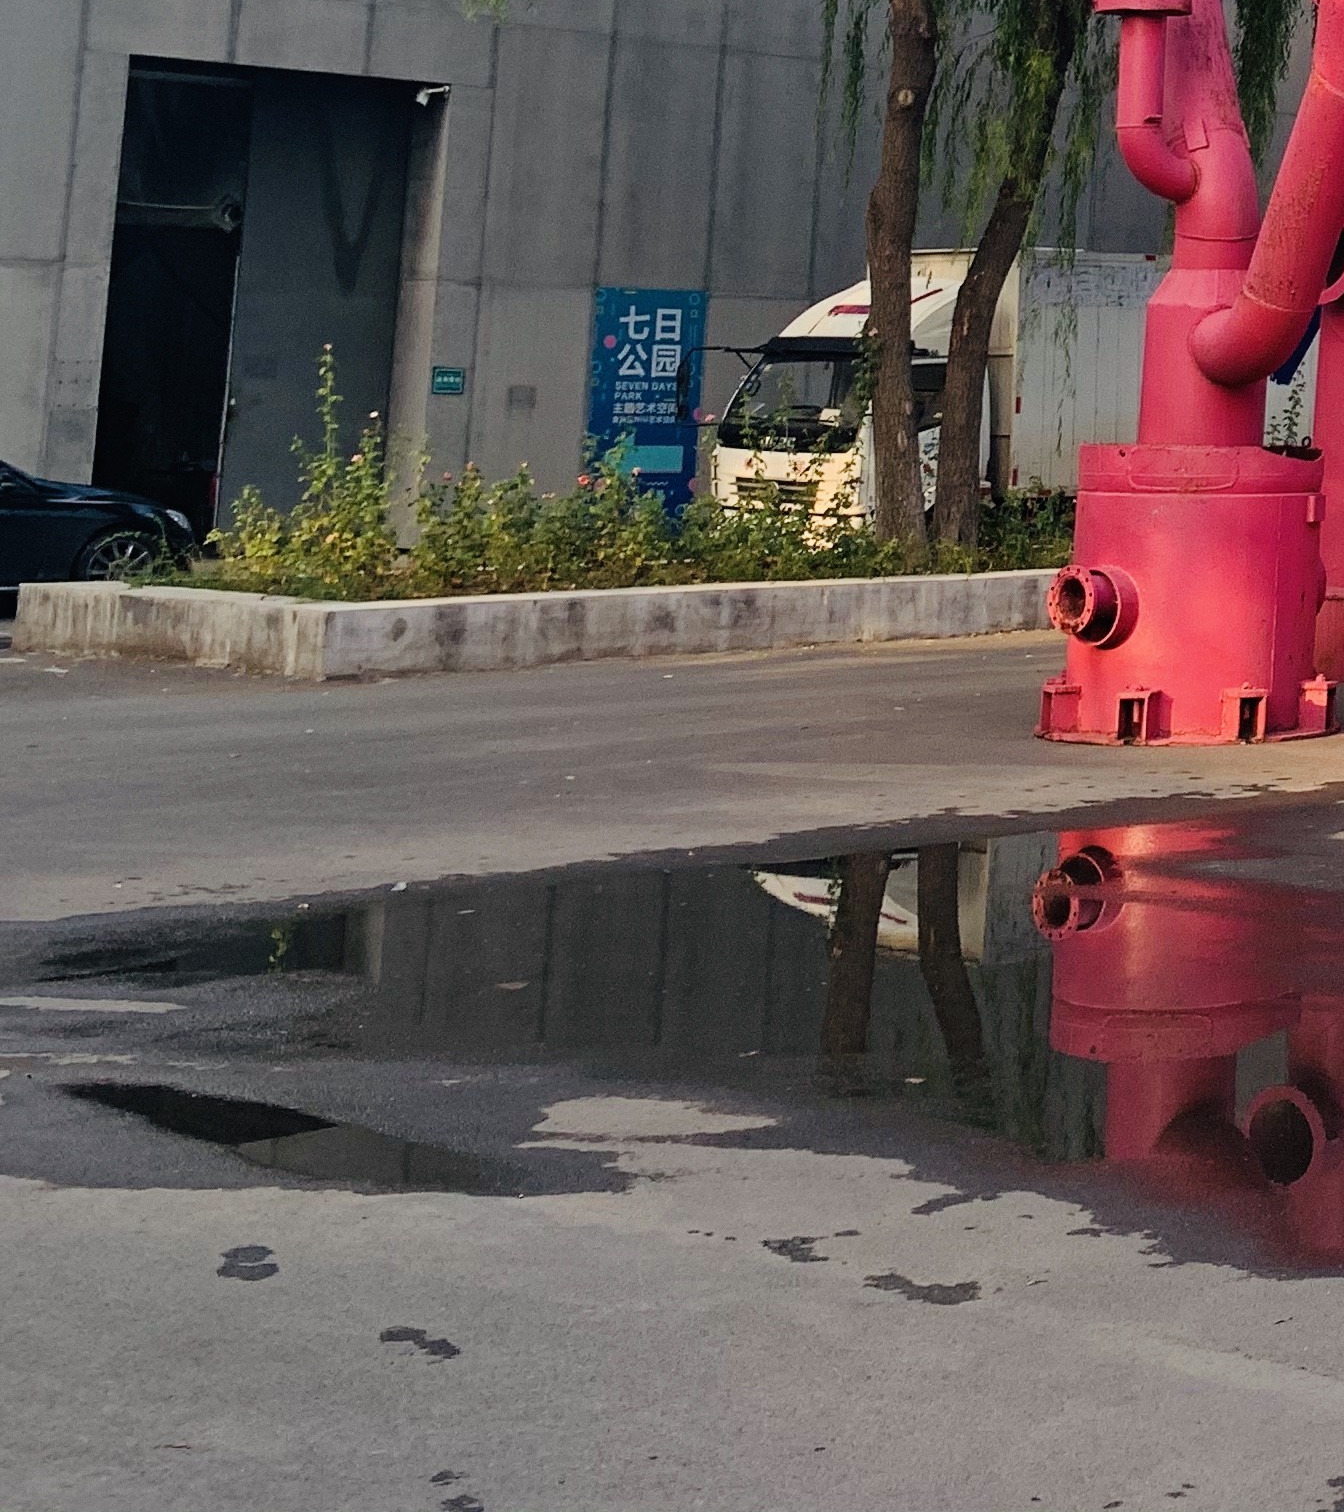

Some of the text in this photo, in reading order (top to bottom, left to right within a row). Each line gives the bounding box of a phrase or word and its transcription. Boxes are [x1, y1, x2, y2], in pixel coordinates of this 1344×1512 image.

[619, 305, 682, 342] 七日
[617, 343, 682, 378] 公园
[614, 391, 643, 401] PARK
[615, 381, 649, 391] SEVEN
